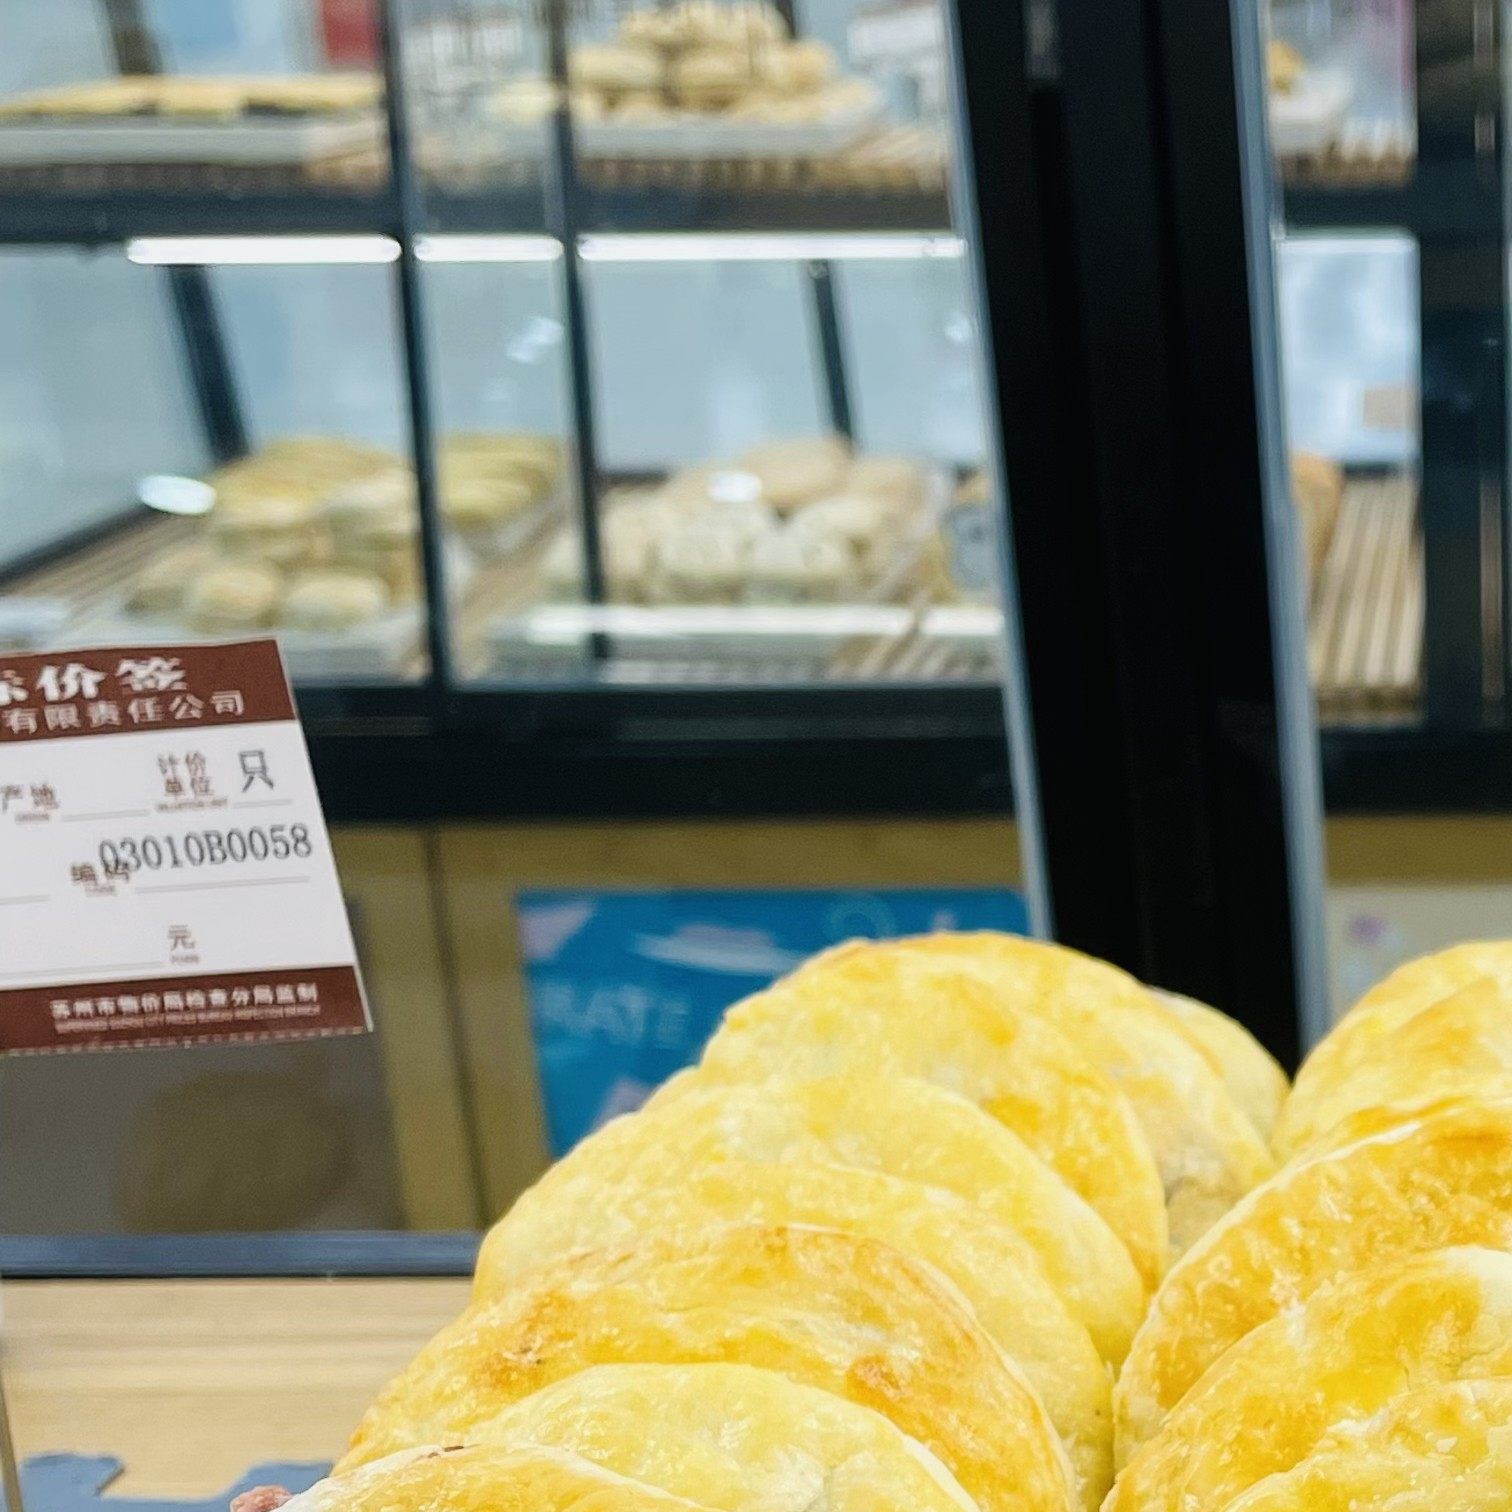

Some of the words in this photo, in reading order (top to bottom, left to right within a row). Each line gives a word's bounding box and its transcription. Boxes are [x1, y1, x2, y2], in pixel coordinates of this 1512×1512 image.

[237, 749, 275, 792] 只
[99, 823, 313, 873] 03010B0058
[168, 924, 197, 952] 元
